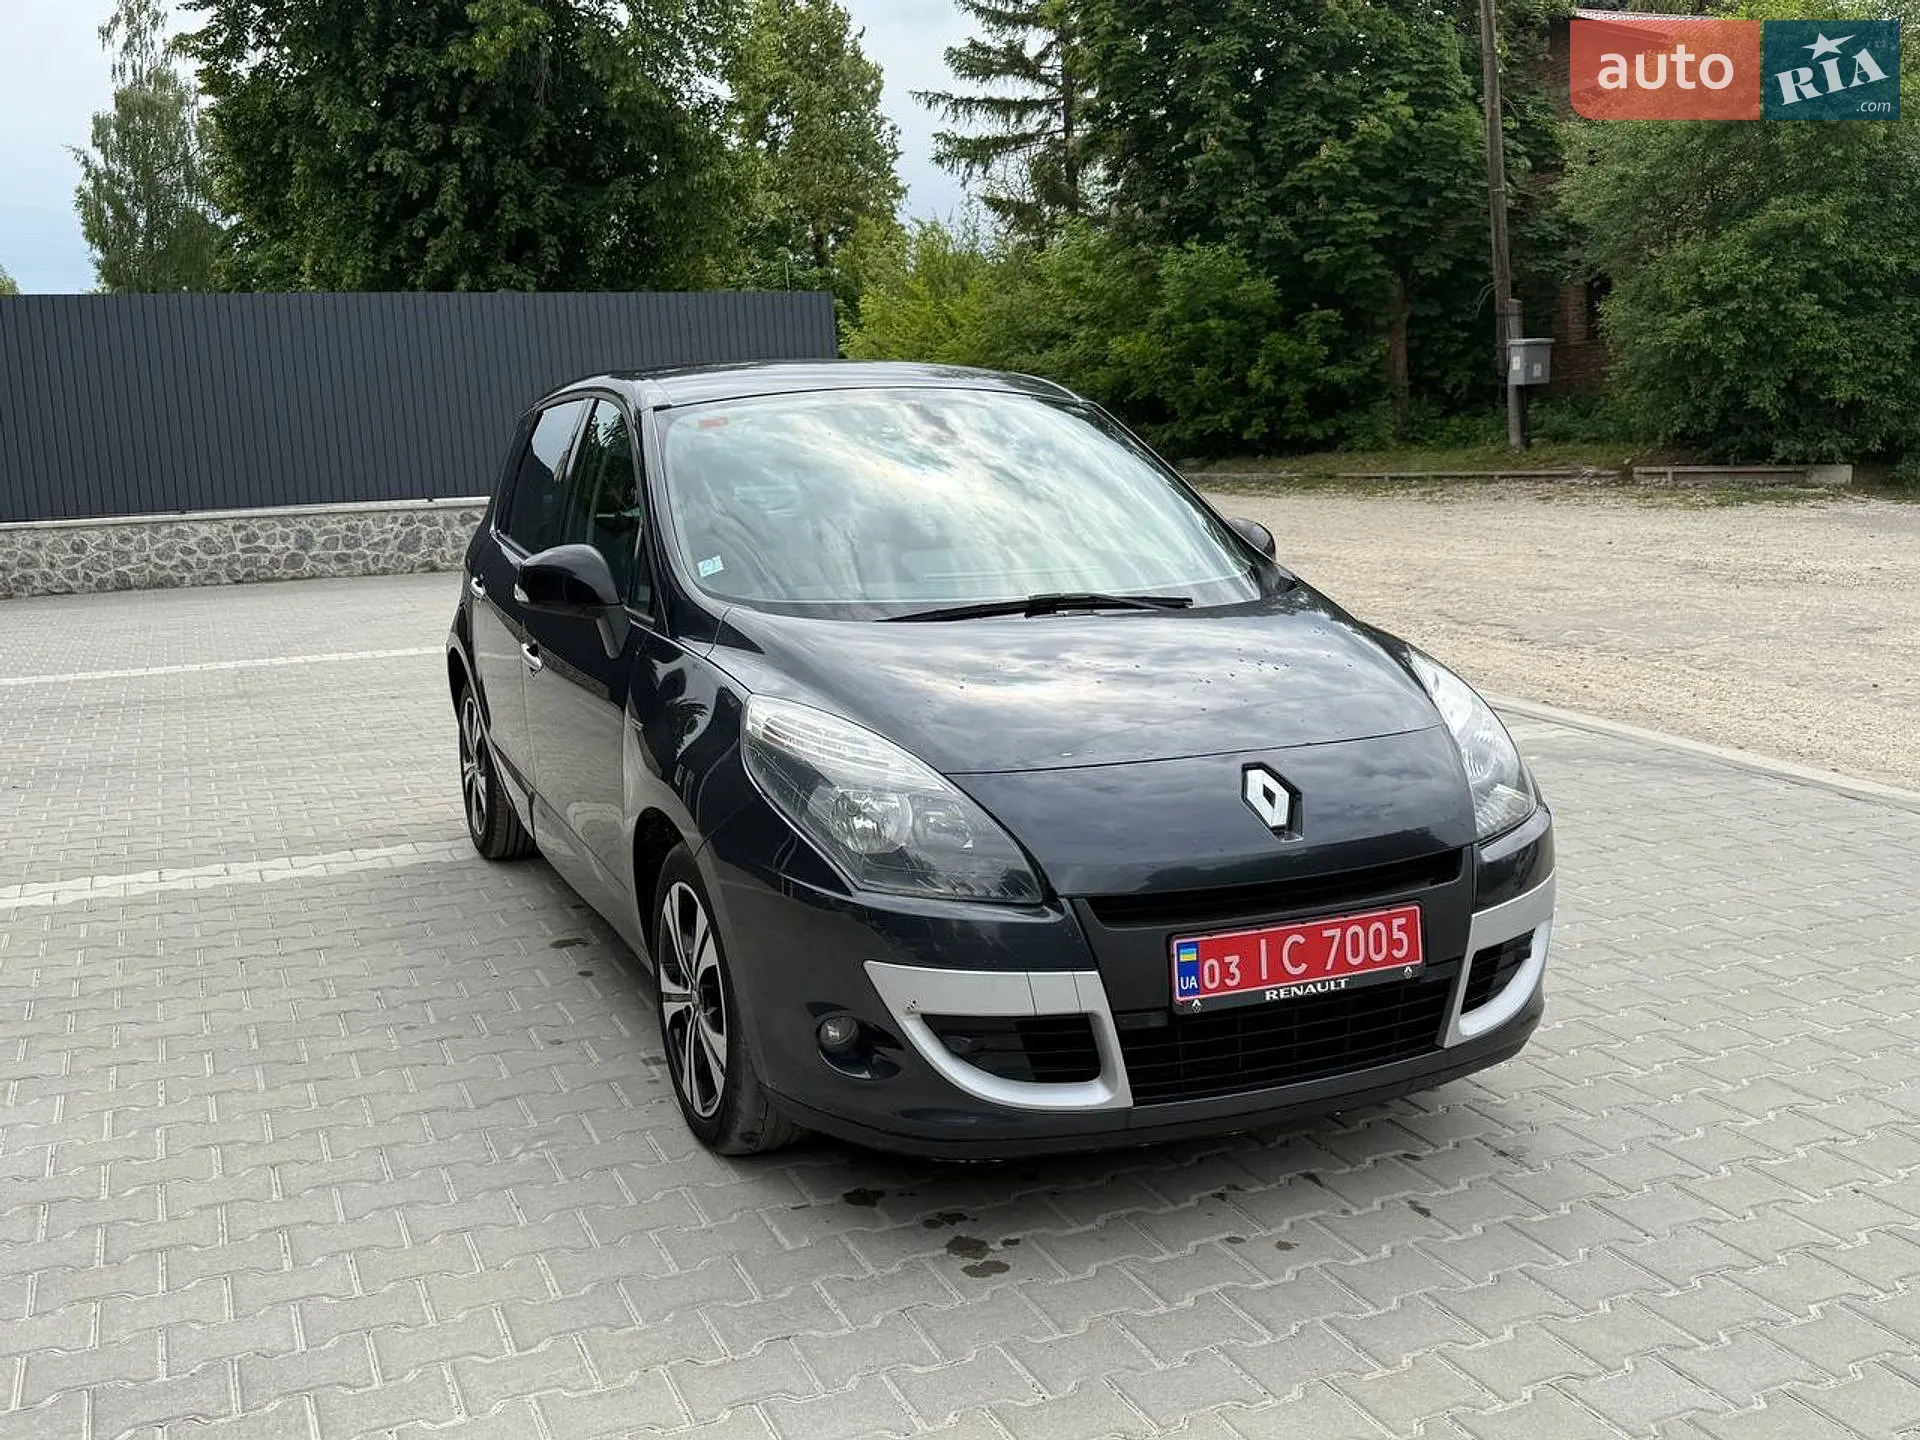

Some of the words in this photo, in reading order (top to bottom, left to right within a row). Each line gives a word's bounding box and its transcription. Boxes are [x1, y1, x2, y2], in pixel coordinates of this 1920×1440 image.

[1203, 955, 1240, 990] 03
[1259, 934, 1308, 980] IC
[1321, 917, 1409, 970] 7005
[1180, 976, 1199, 990] UA
[1265, 978, 1349, 1000] RENAULT
